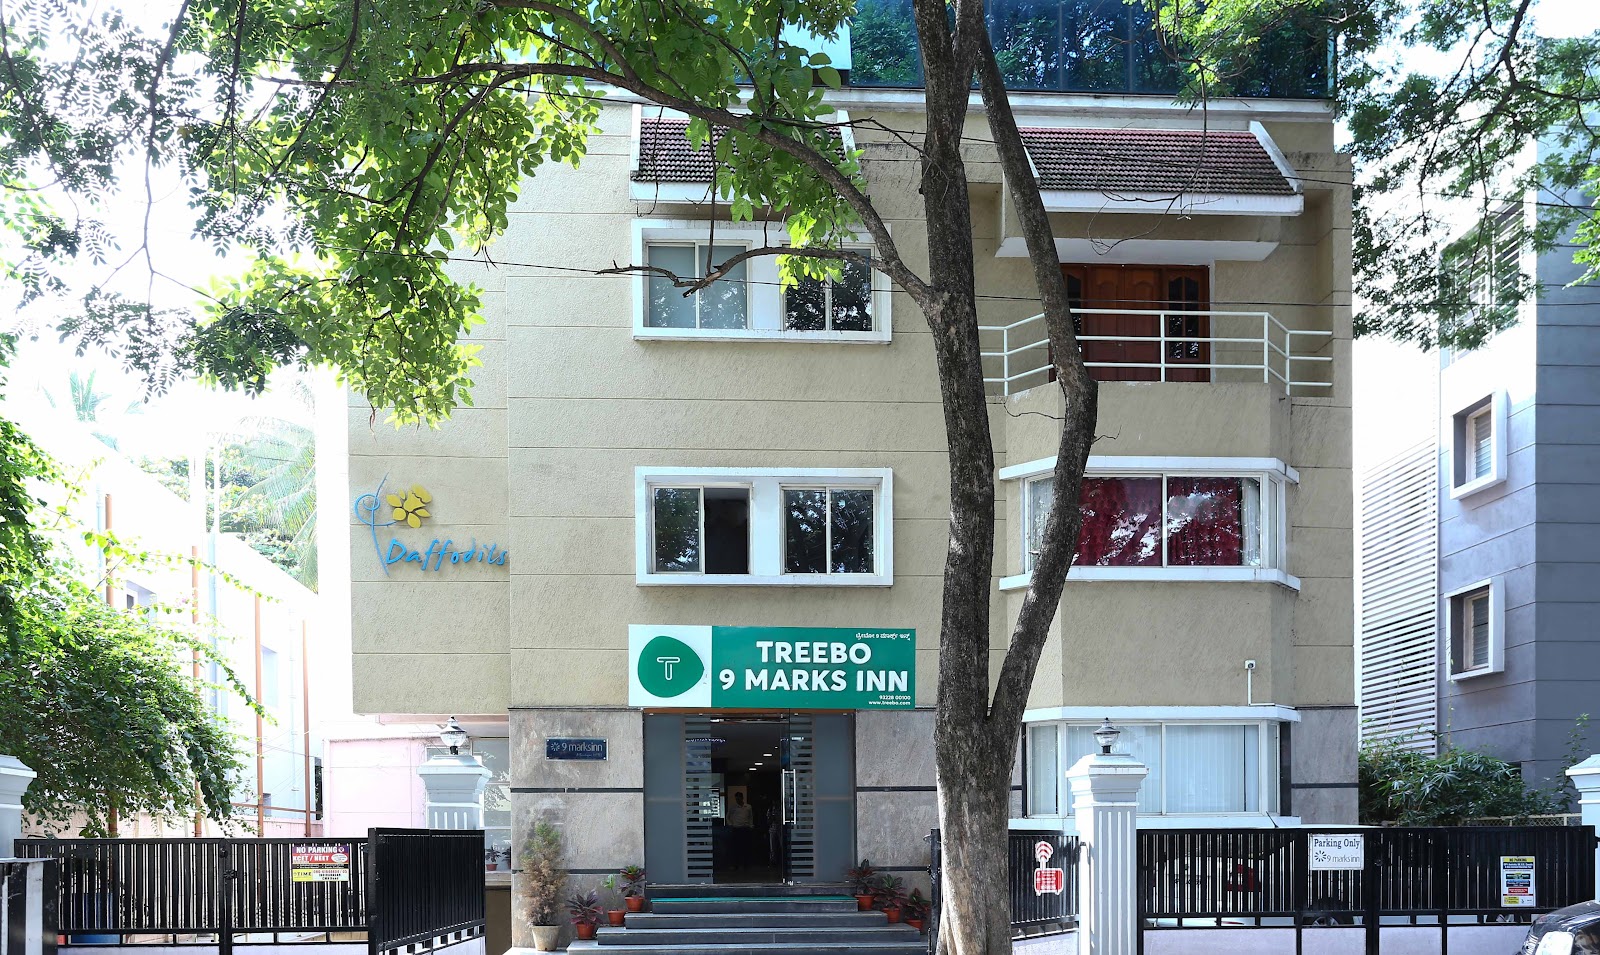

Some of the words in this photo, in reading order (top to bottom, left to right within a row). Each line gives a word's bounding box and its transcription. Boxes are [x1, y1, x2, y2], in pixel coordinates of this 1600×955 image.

[386, 538, 507, 571] Daffodils
[756, 641, 871, 665] TREEBO
[719, 669, 735, 690] 9
[745, 669, 847, 691] MARKS
[856, 670, 908, 692] INN
[561, 742, 568, 751] 9
[296, 846, 306, 854] NO
[308, 846, 338, 854] PARKING
[1314, 838, 1342, 850] Parking
[1343, 838, 1361, 850] Only
[1326, 854, 1332, 862] 9
